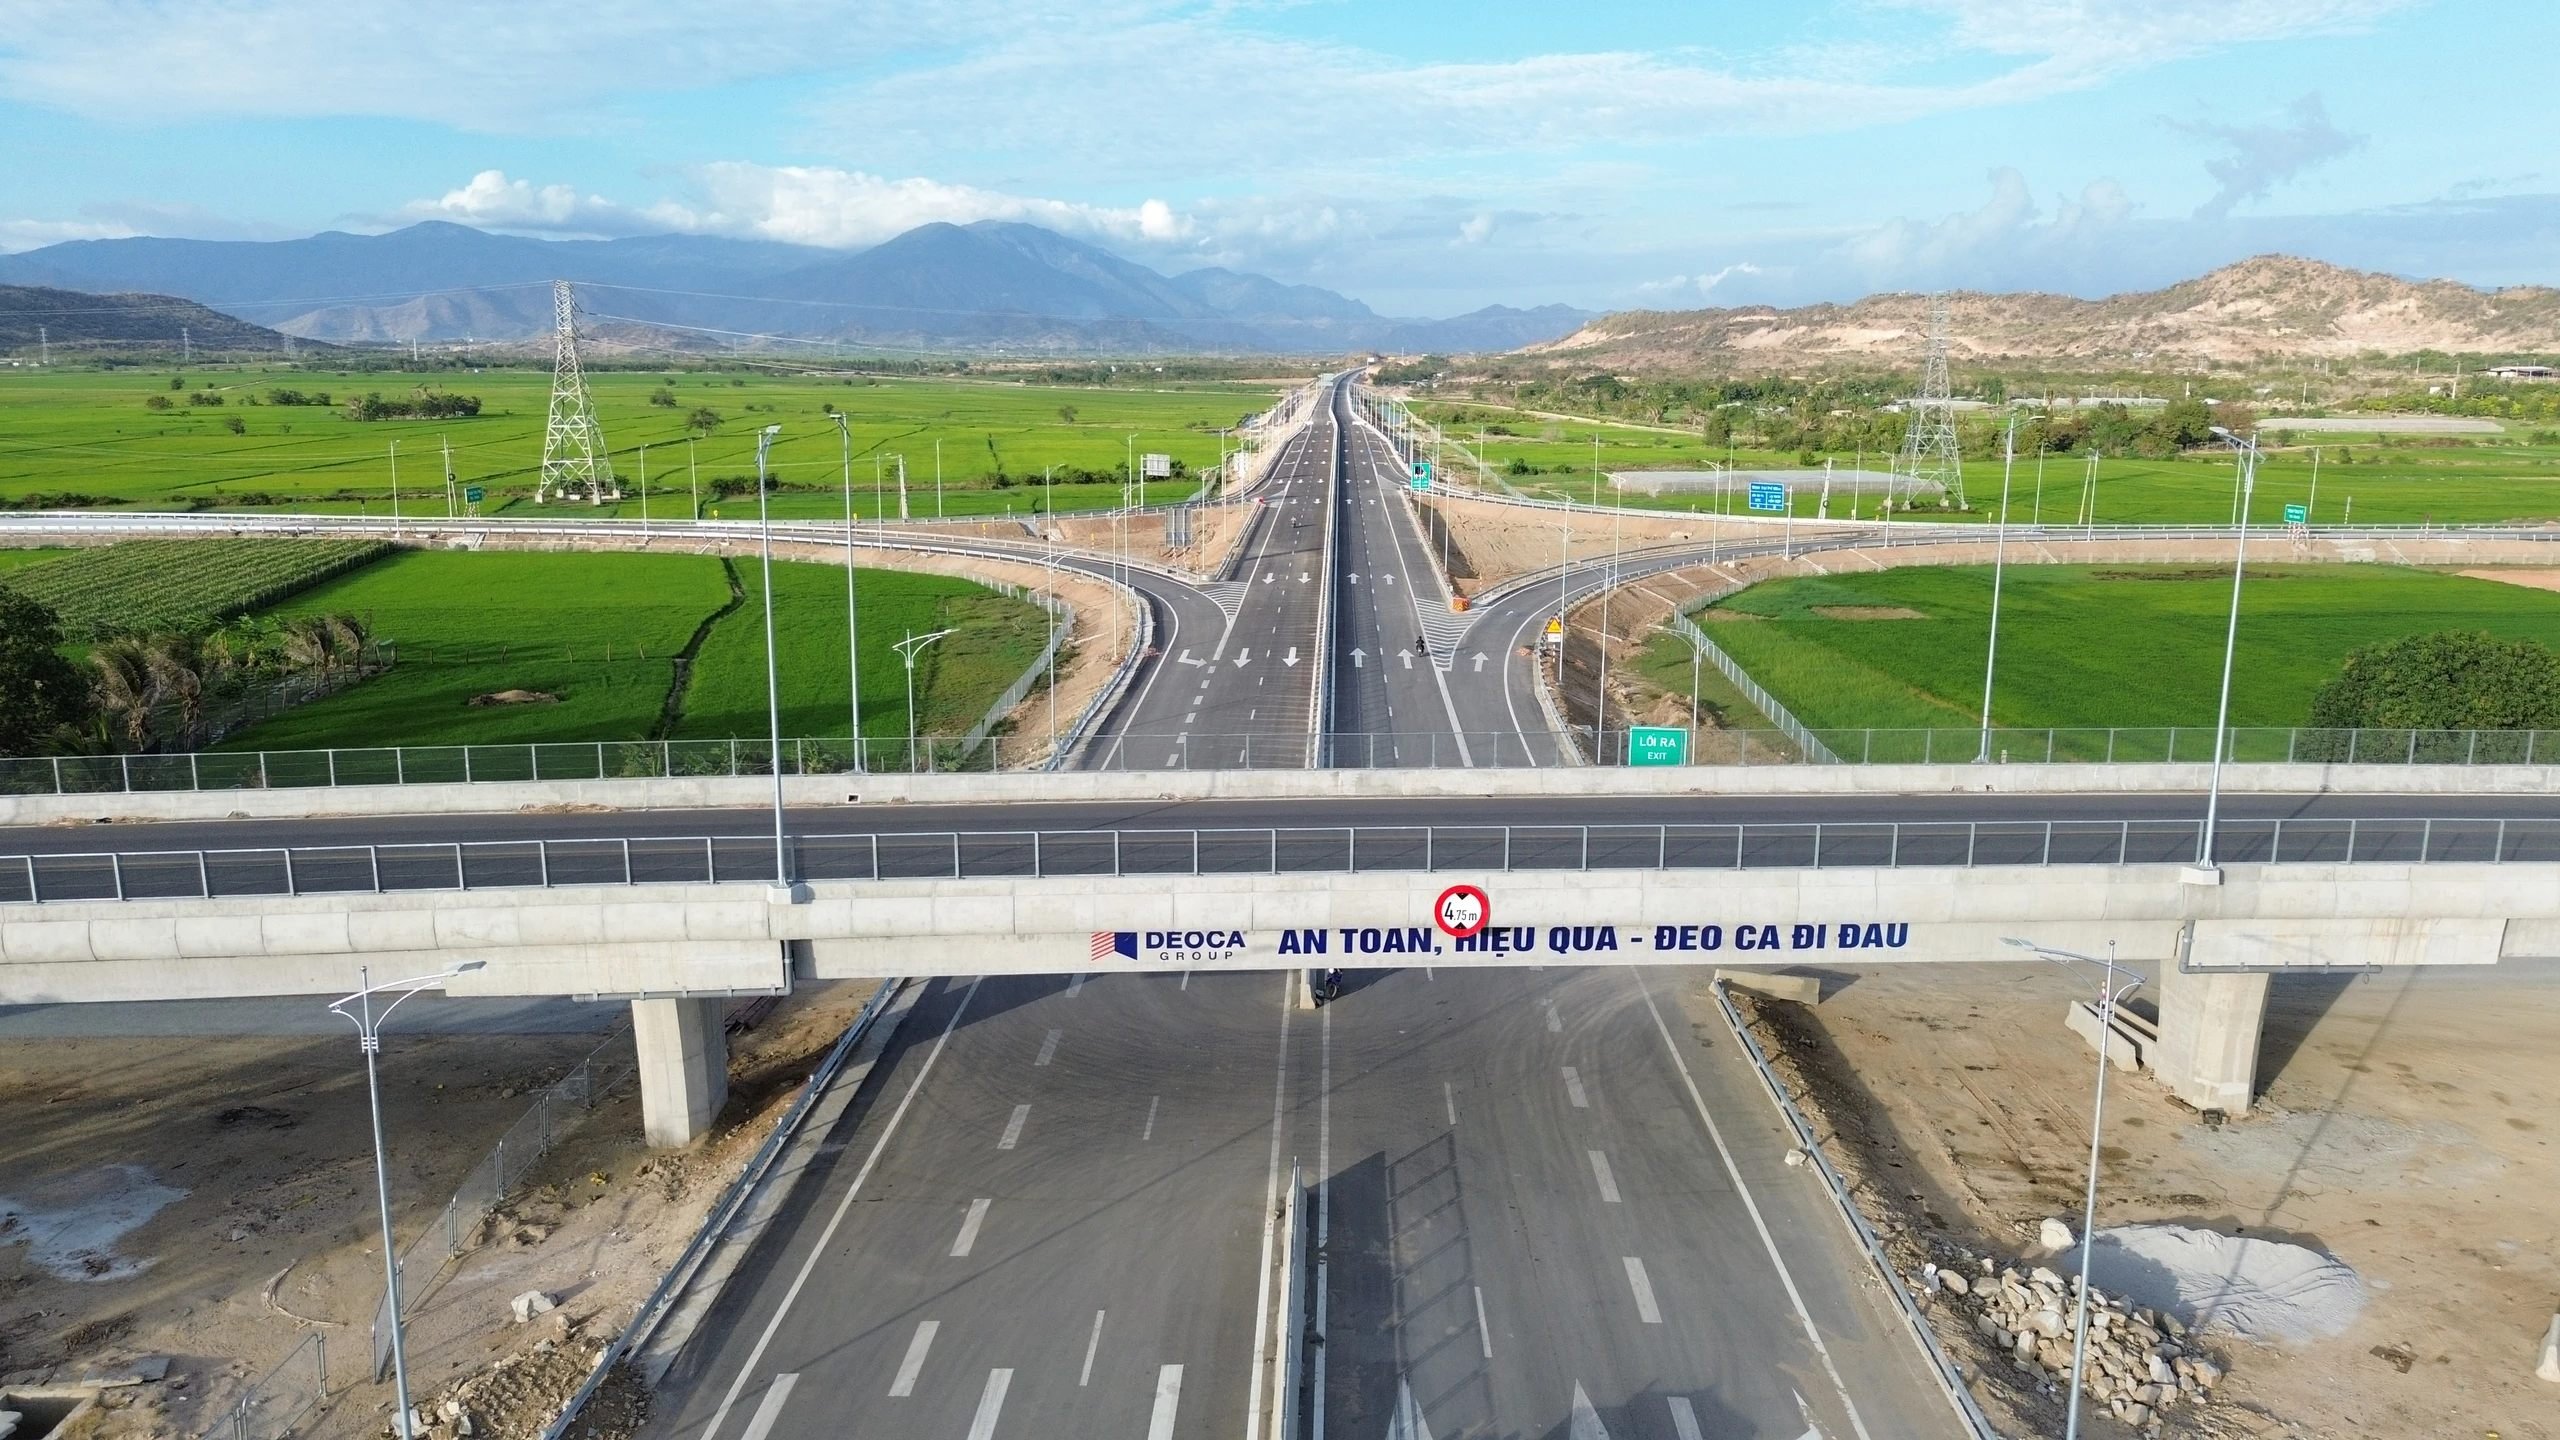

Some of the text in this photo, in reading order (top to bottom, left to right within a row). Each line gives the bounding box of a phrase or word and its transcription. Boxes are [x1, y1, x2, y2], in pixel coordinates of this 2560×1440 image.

[1660, 738, 1676, 748] RA
[1647, 752, 1667, 760] EXIT
[1145, 930, 1246, 949] DEOCA
[1278, 928, 1328, 954] AN
[1792, 924, 1826, 949] ĐI
[1160, 951, 1233, 961] GROUP
